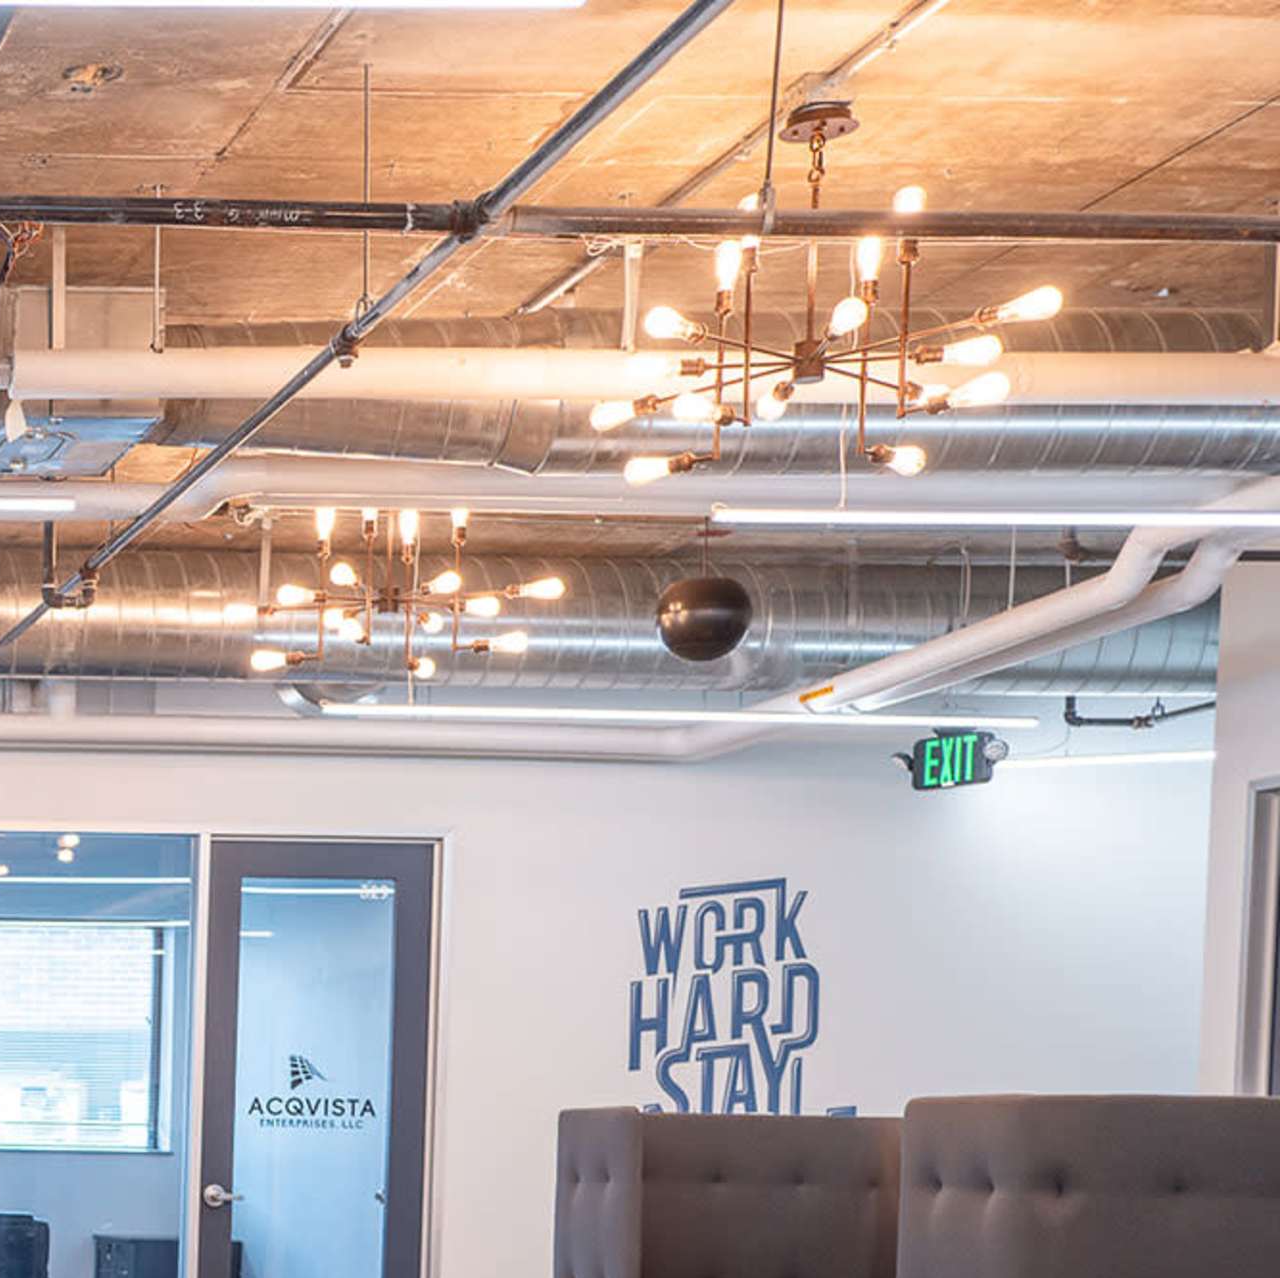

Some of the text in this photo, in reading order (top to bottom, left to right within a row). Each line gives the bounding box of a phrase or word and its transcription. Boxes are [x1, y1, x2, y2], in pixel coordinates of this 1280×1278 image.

[924, 733, 978, 787] EXIT
[637, 877, 809, 977] WORK
[628, 962, 820, 1072] HARD
[248, 1097, 376, 1117] ACQVISTA
[656, 1042, 792, 1117] STAY
[341, 1119, 364, 1130] LLC
